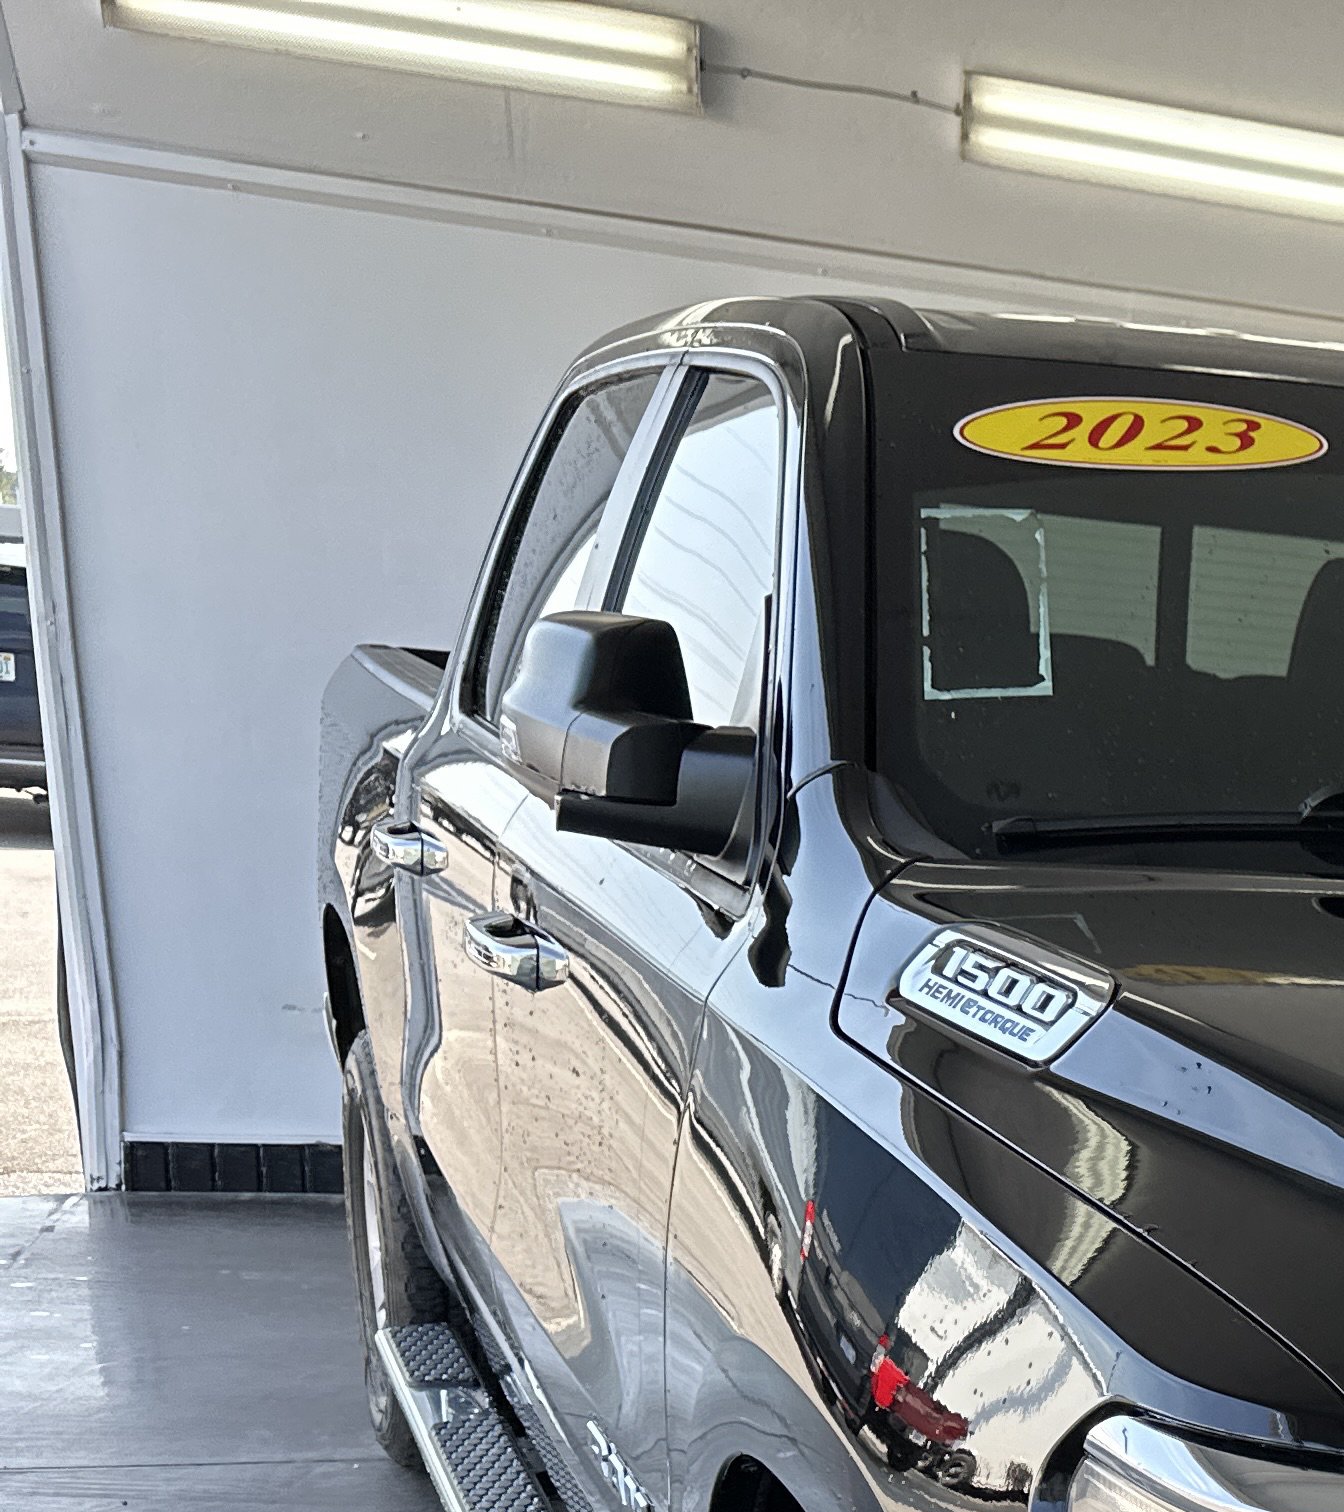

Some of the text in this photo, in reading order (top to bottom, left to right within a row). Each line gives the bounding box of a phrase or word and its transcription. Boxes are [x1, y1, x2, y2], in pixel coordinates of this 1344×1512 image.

[1020, 411, 1263, 455] 2023
[917, 978, 967, 1009] HEMI
[942, 945, 1072, 1023] 1500
